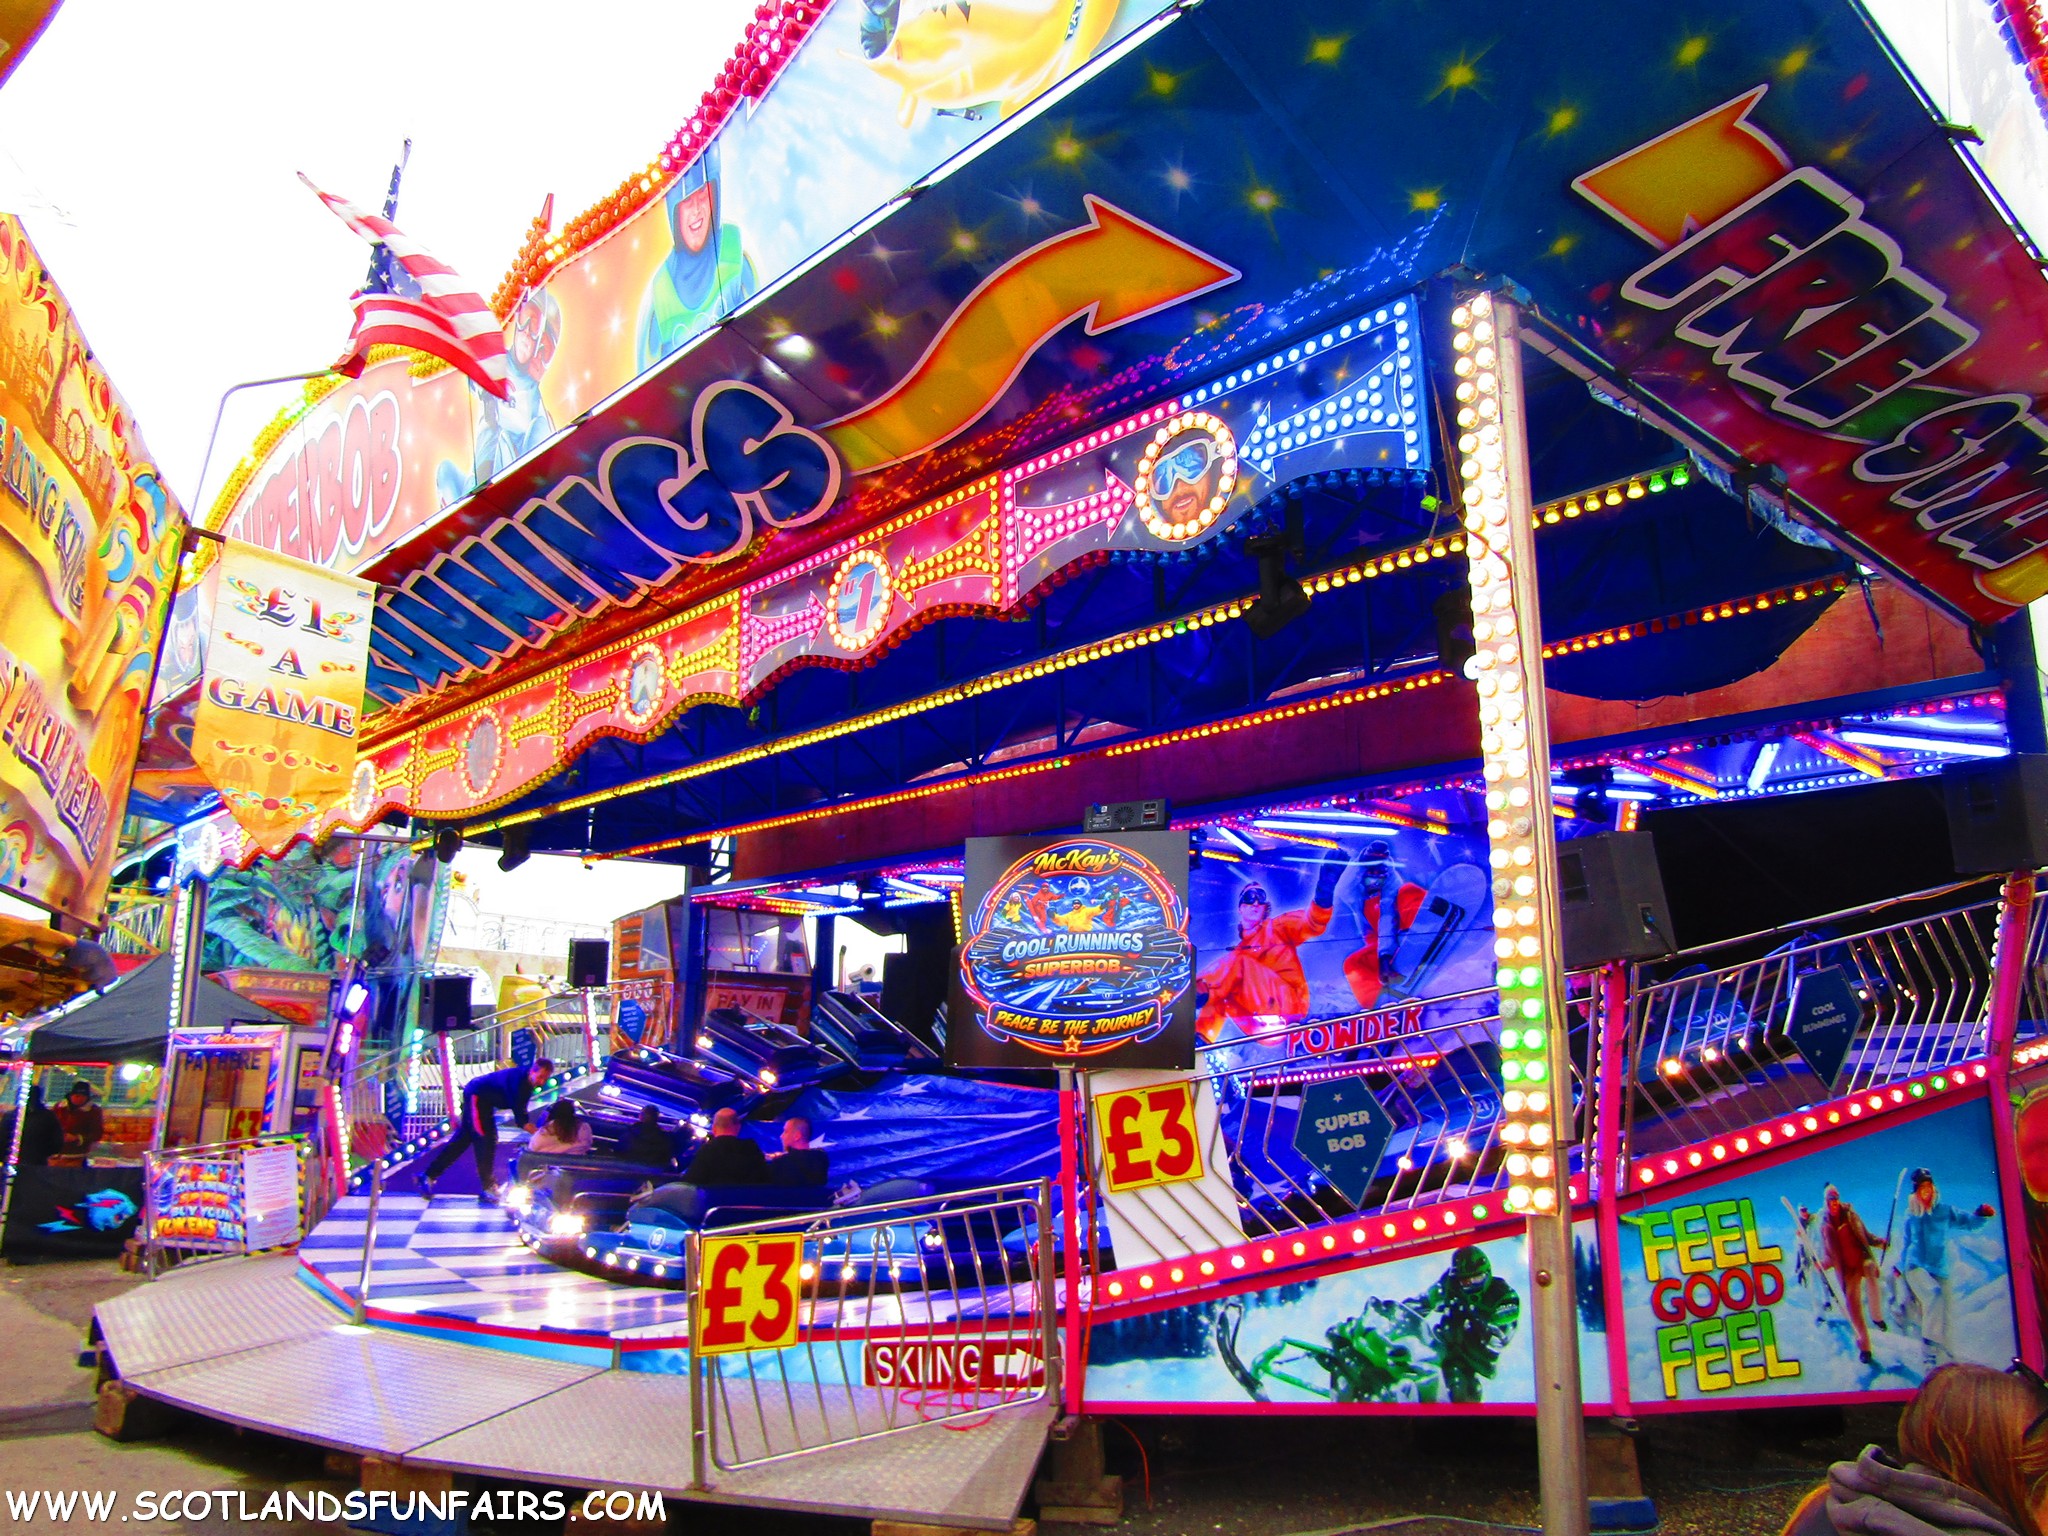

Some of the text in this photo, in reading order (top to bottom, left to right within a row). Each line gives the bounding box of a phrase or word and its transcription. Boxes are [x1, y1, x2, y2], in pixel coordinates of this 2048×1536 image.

[1622, 166, 1980, 428] FREE
[231, 390, 402, 570] UPERBOB
[257, 586, 328, 638] £1
[268, 647, 308, 679] A
[207, 675, 357, 738] GAME
[1034, 849, 1123, 873] McKay's
[1003, 932, 1143, 962] COOL RUNNINGS
[1024, 959, 1121, 979] SUPERBOB
[756, 995, 775, 1010] IN
[994, 1008, 1154, 1036] PEACE BE THE JOURNEY
[1286, 997, 1424, 1059] POWDER
[1811, 1002, 1836, 1016] COOL
[1106, 1088, 1195, 1184] £3
[1315, 1110, 1371, 1134] SUPER
[1327, 1133, 1366, 1153] BOB
[1638, 1197, 1782, 1282] FEEL
[702, 1241, 796, 1347] £3
[1651, 1263, 1784, 1323] GOOD
[1656, 1309, 1801, 1399] FEEL
